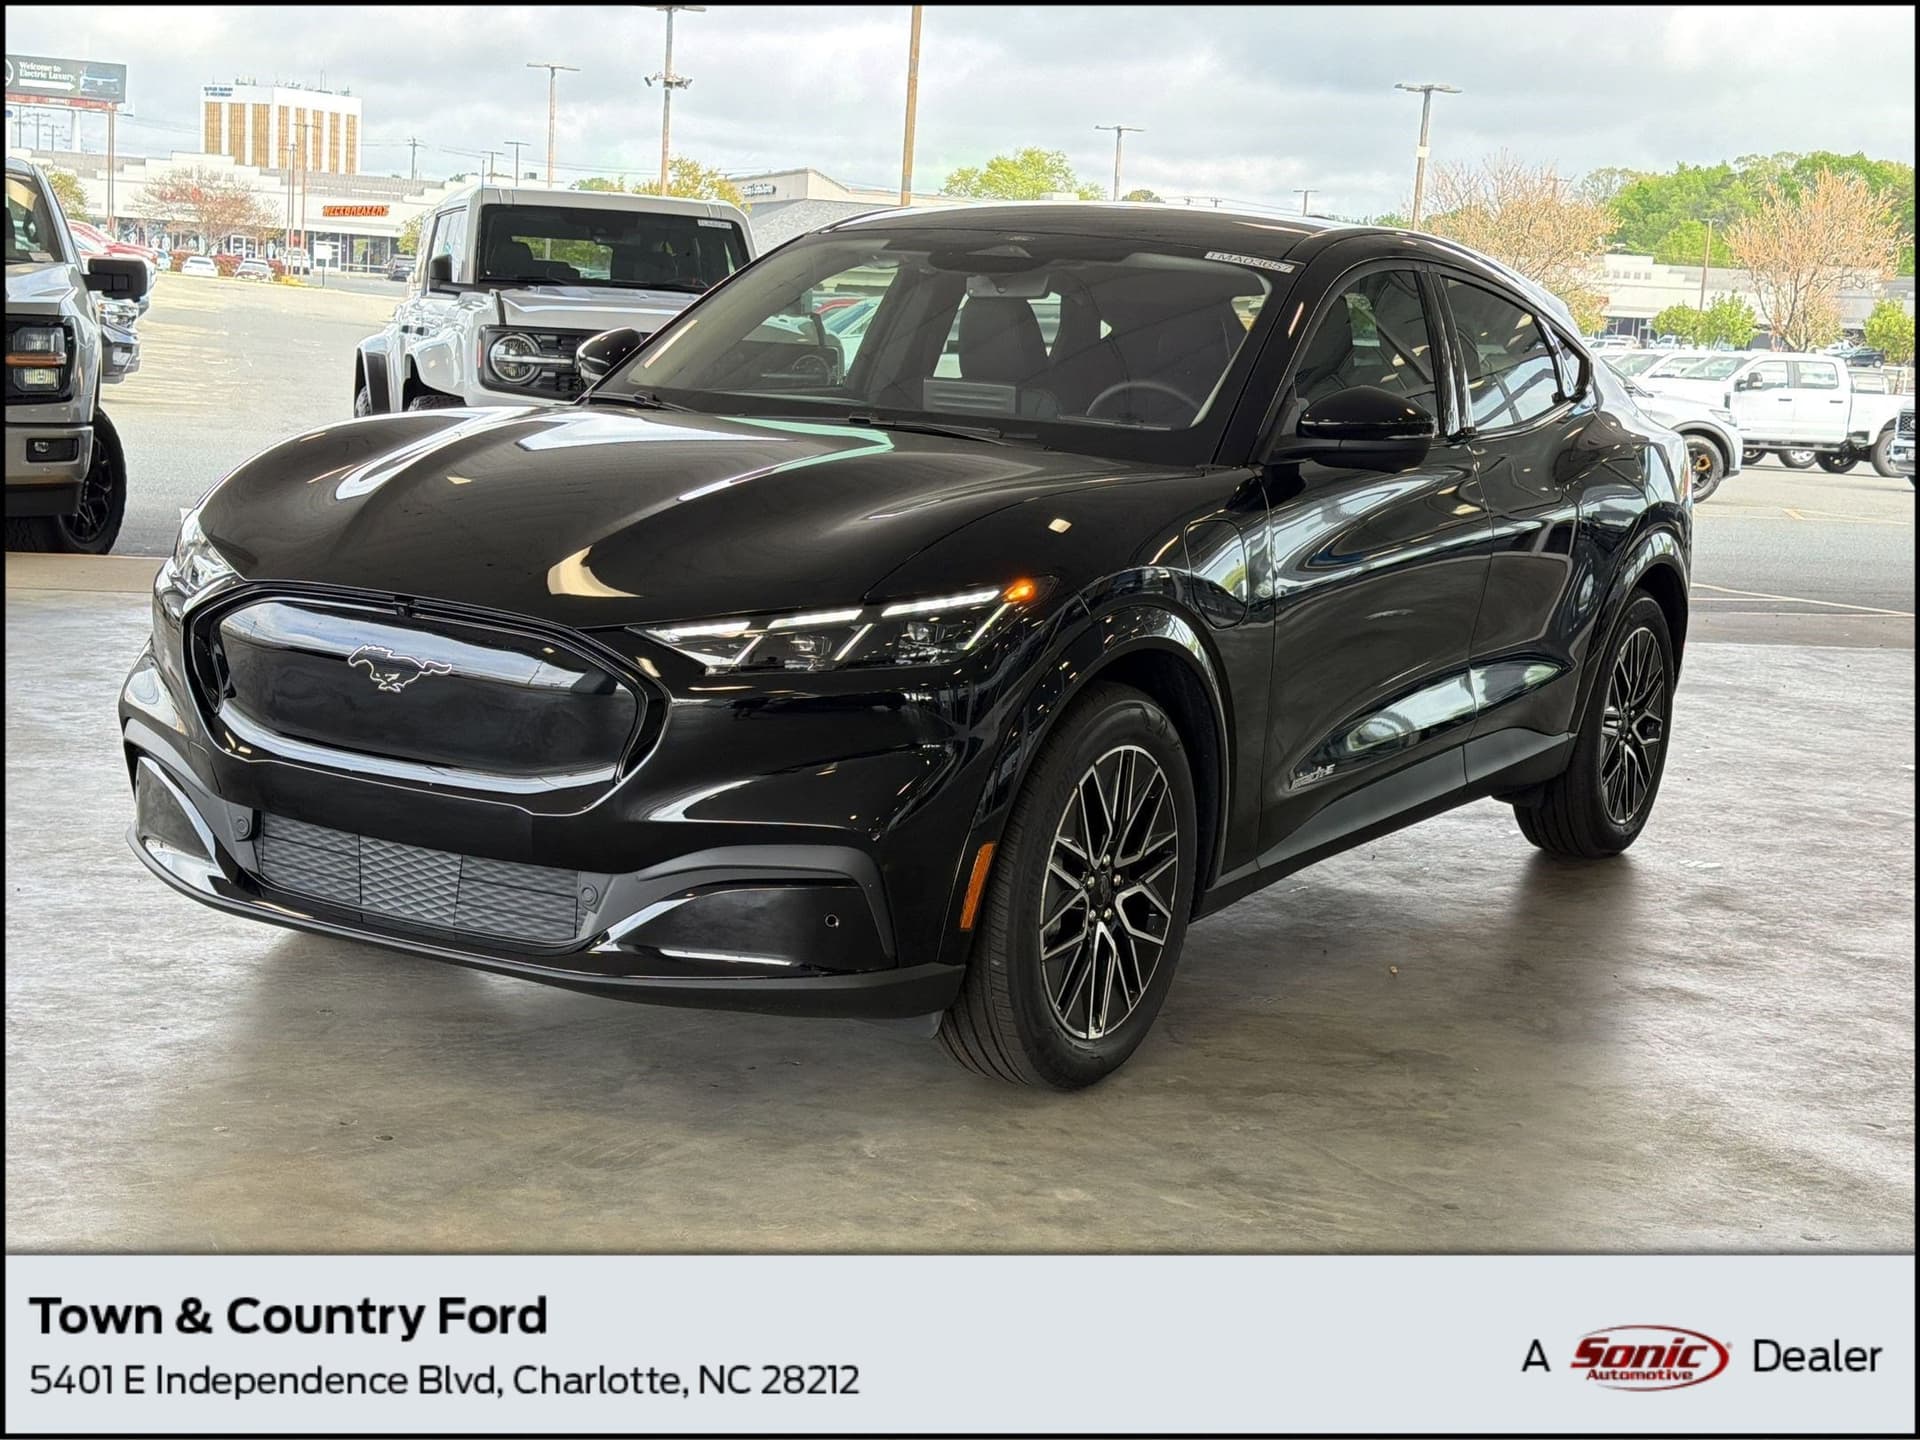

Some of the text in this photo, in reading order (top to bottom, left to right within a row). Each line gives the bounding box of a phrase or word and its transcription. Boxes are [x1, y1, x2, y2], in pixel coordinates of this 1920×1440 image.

[19, 61, 52, 71] Welcome
[20, 70, 76, 82] Electric Luxury.
